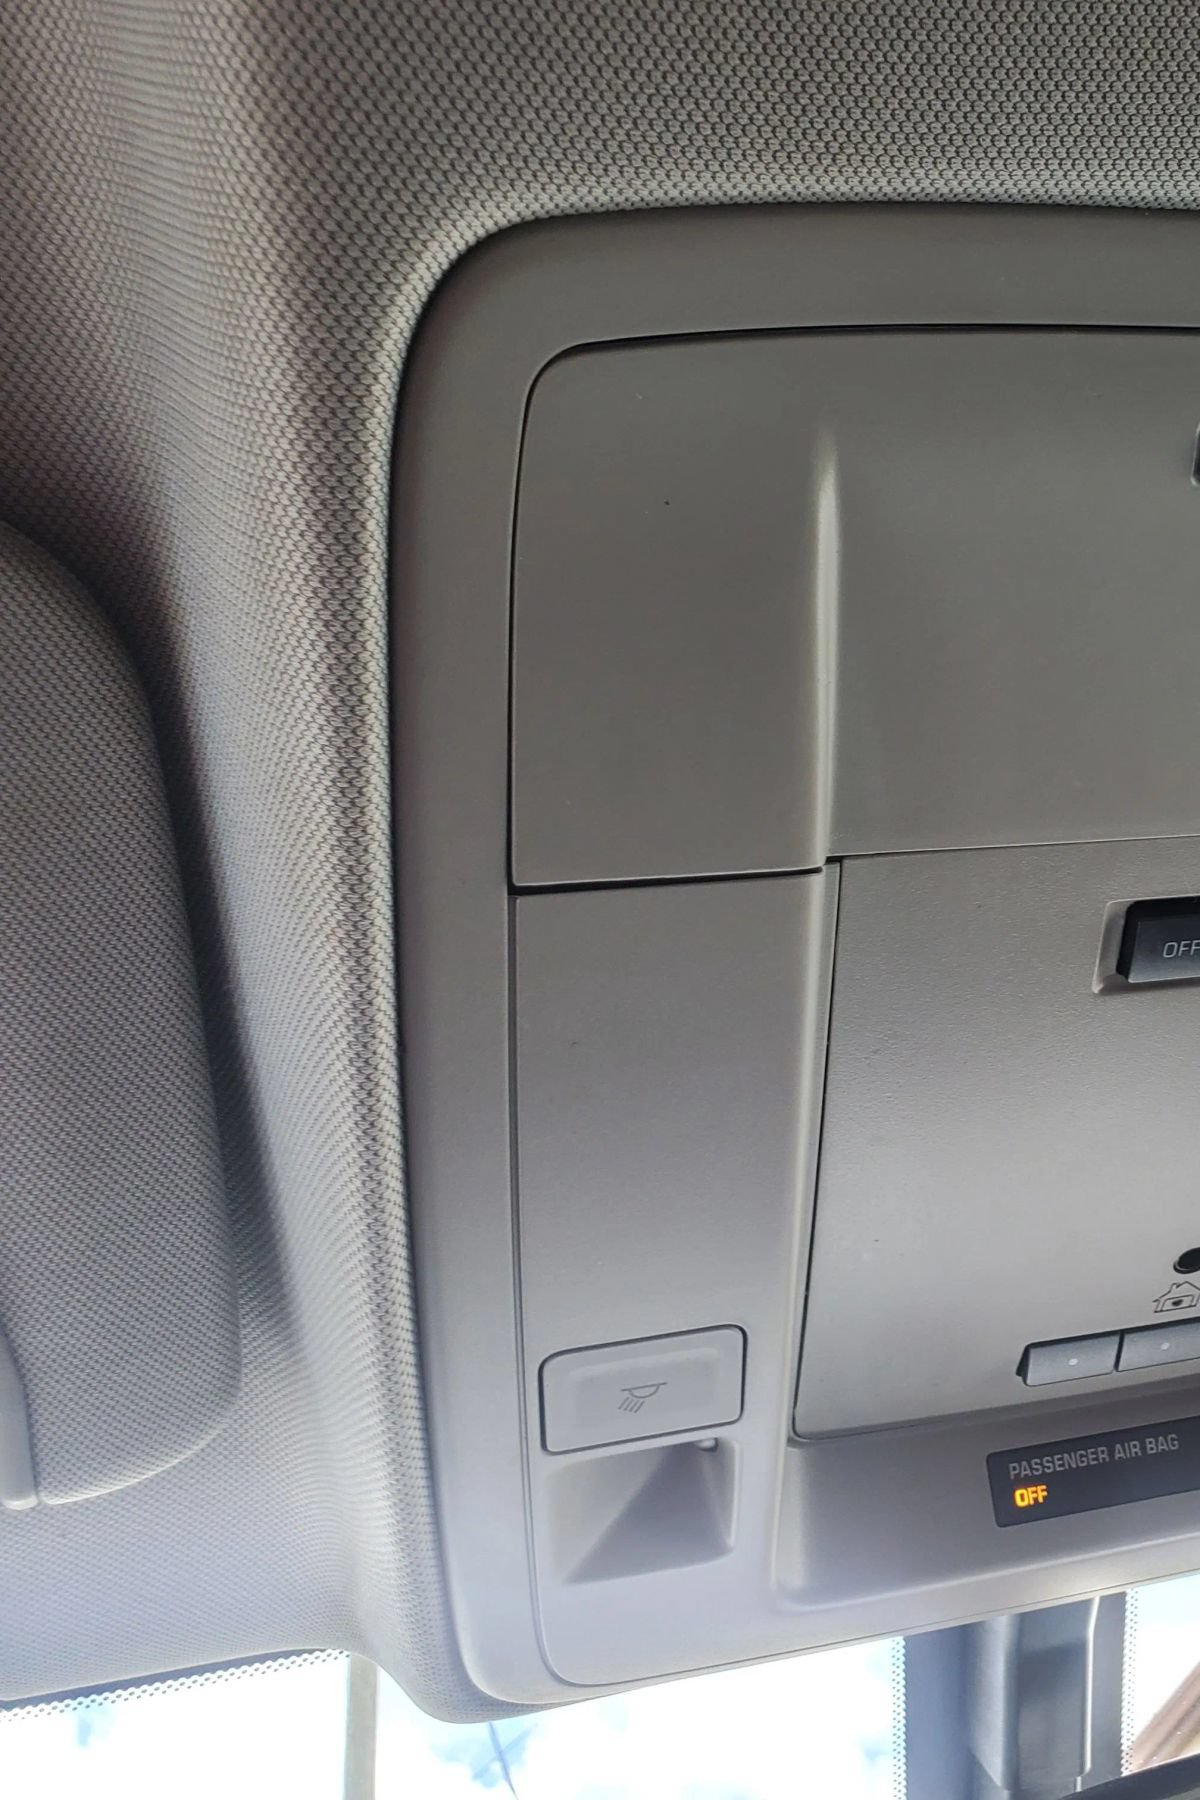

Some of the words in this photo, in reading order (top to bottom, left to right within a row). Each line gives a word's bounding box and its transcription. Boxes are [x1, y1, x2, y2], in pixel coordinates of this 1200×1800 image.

[1008, 1446, 1110, 1480] PASSENGER
[1114, 1440, 1142, 1462] AIR
[1145, 1433, 1180, 1455] BAG
[1014, 1484, 1048, 1508] OFF
